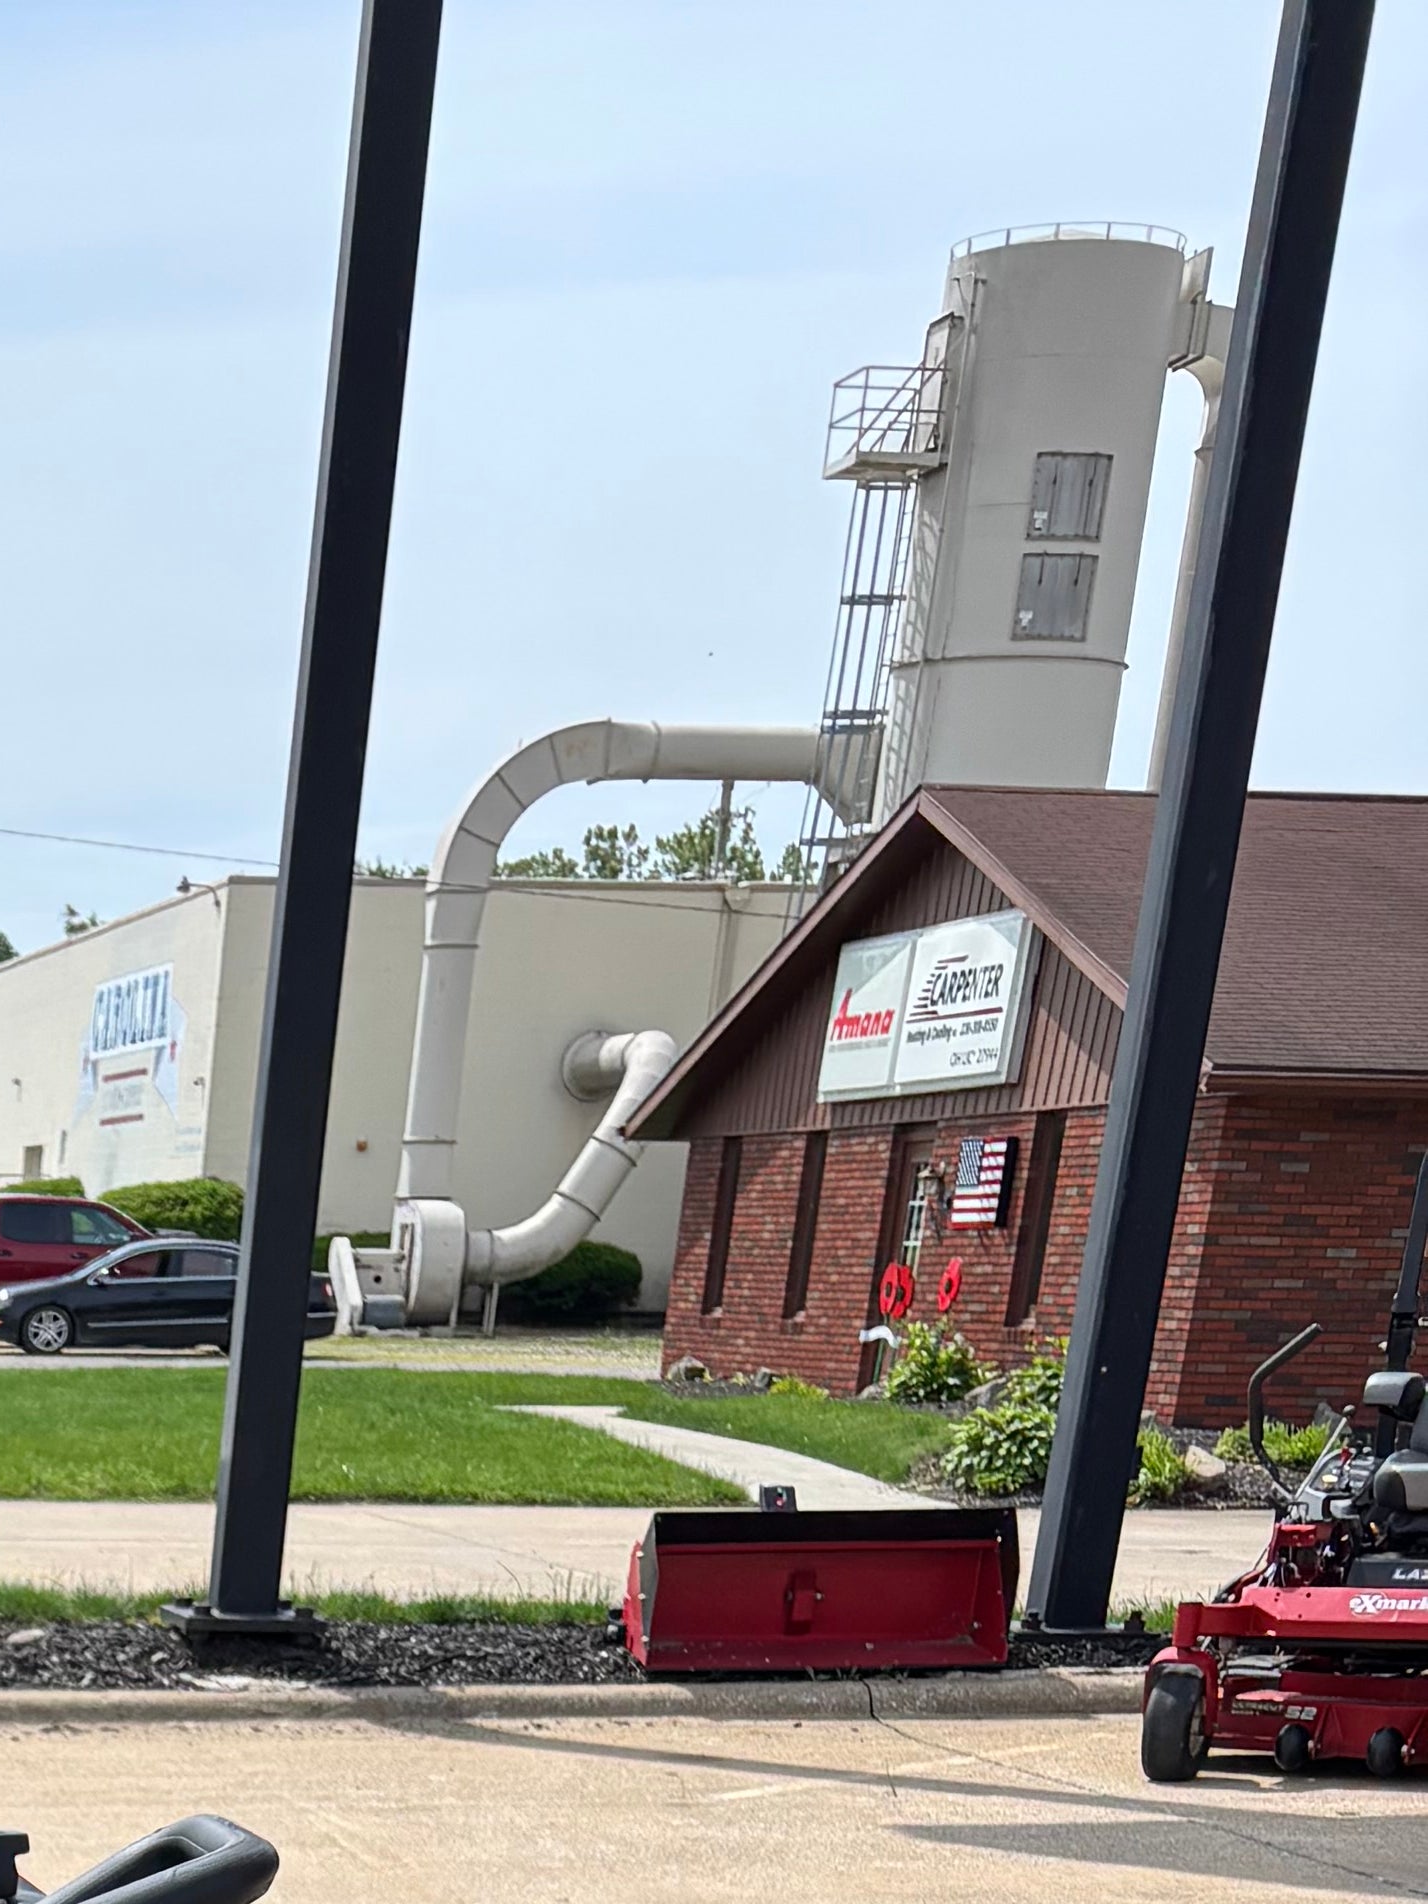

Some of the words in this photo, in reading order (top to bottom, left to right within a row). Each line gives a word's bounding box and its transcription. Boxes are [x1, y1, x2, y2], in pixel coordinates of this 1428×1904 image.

[929, 962, 1005, 1008] CARPENTER
[829, 987, 896, 1042] Amana
[1285, 1705, 1318, 1721] 52
